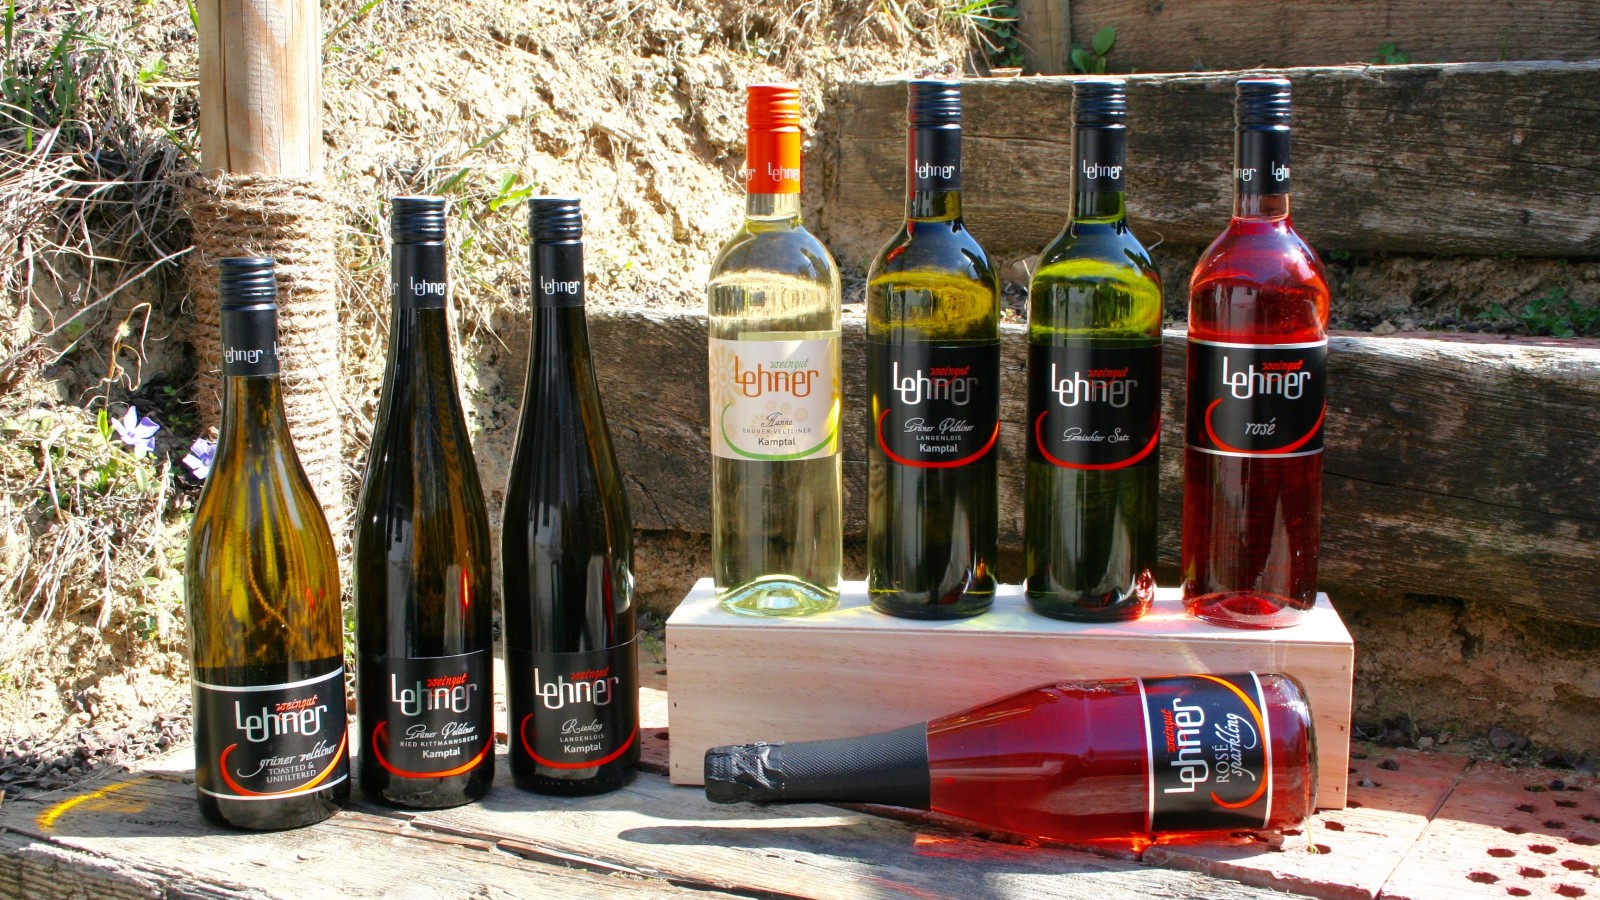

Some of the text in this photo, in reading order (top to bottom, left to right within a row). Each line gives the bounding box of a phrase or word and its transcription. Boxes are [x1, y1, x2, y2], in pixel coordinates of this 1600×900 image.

[915, 159, 955, 179] Lehner
[1083, 159, 1123, 180] Lehner
[410, 275, 447, 296] Lehner
[541, 275, 580, 295] Lehner
[222, 342, 264, 364] Lehner
[735, 355, 819, 398] Lehner
[769, 359, 810, 380] weingut
[930, 365, 971, 386] weingut
[1087, 367, 1129, 388] weingut
[1222, 356, 1311, 400] Lehner
[1262, 359, 1305, 381] weingut
[893, 361, 979, 406] Lehner
[1051, 363, 1138, 408] Lehner
[773, 427, 811, 435] VELTLINER
[1062, 427, 1130, 444] Gemischter Satz
[1245, 417, 1277, 436] rosé
[758, 437, 796, 448] Kamptal
[919, 443, 958, 454] Kamptal
[426, 672, 469, 697] weingut
[534, 667, 619, 710] Lehner
[570, 666, 610, 690] weingut
[391, 673, 478, 716] Lehner
[275, 694, 318, 720] weingut
[235, 700, 328, 743] Lehner
[561, 718, 603, 735] Riesling
[1160, 708, 1187, 753] weingut
[400, 734, 479, 748] RIED KITTMANNSBERG
[560, 733, 605, 743] LANGENLOIS
[564, 742, 602, 754] Kamptal
[1163, 698, 1209, 794] Lehner
[1214, 713, 1257, 782] sparkling
[299, 739, 337, 763] veltliner
[422, 747, 461, 759] Kamptal
[268, 761, 315, 776] TOASTED &
[1211, 744, 1230, 783] ROSÉ
[266, 769, 317, 784] UNFILTERED
